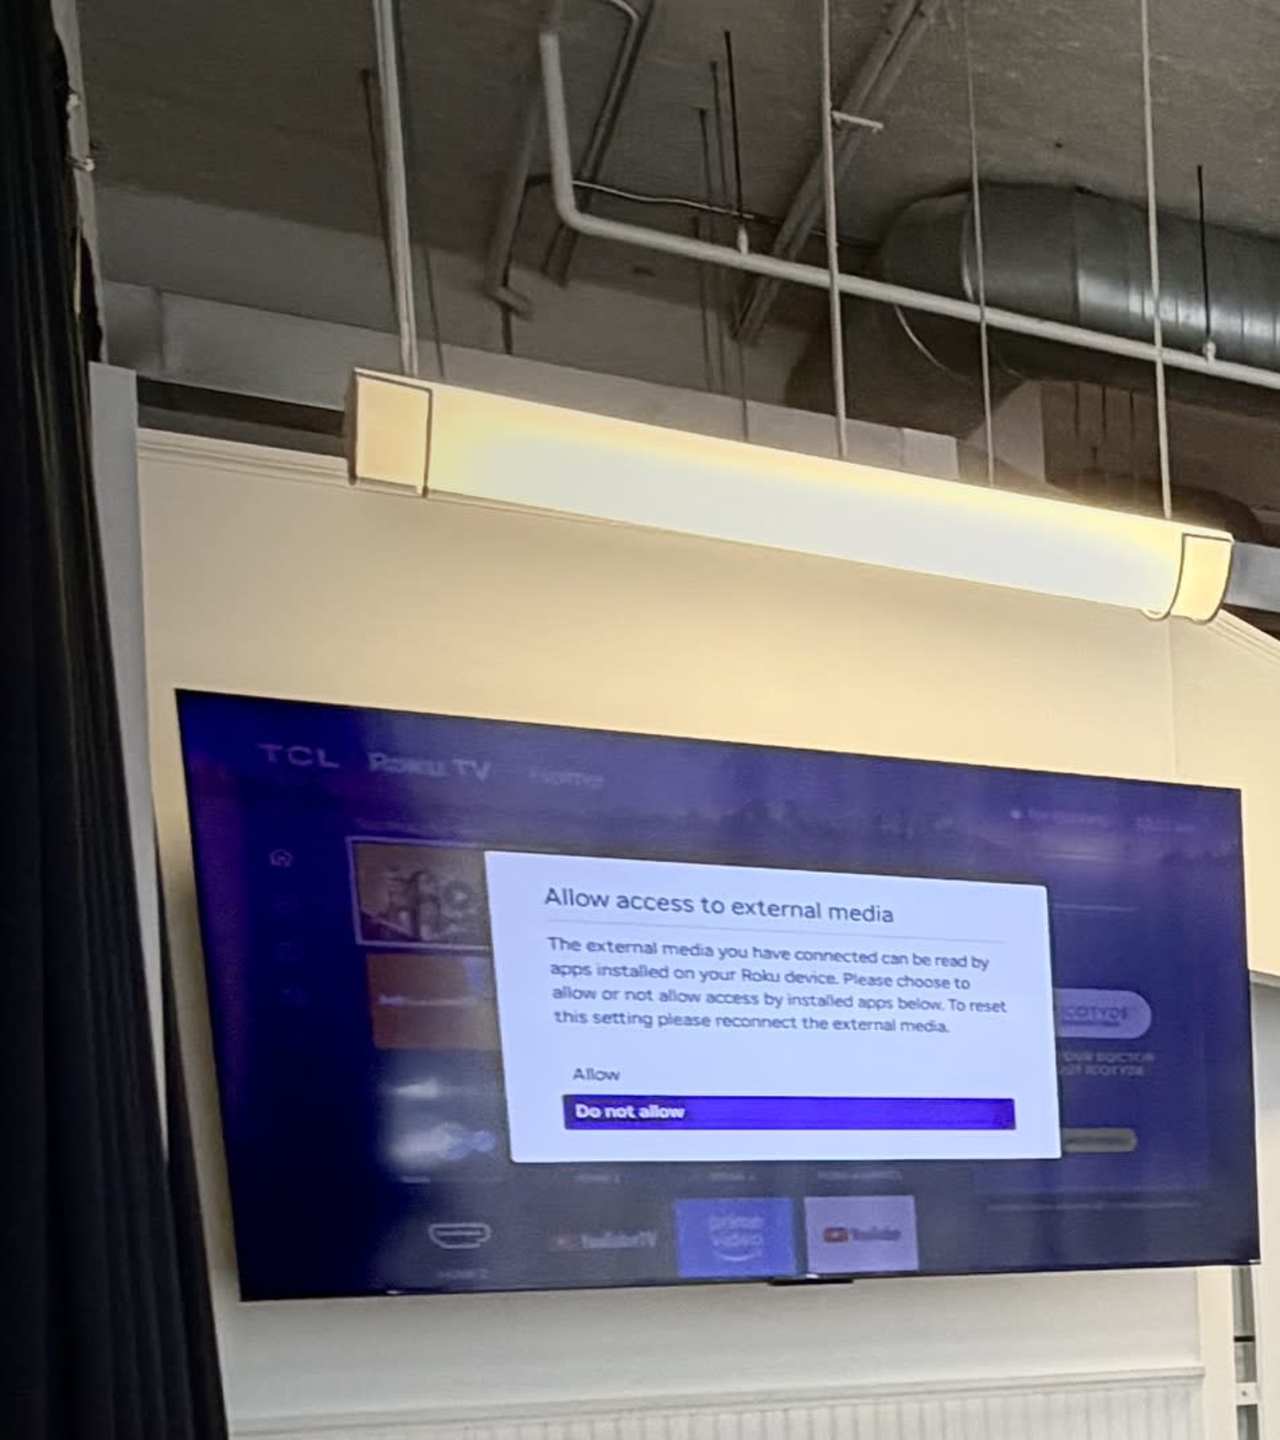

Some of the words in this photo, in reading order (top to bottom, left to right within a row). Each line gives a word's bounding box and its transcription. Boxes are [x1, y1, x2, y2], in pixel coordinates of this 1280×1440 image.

[258, 744, 339, 768] TCL
[453, 758, 492, 781] TV
[545, 887, 610, 908] Allow
[616, 894, 695, 913] access
[701, 896, 726, 915] to
[731, 900, 821, 920] external
[829, 904, 894, 923] media
[548, 936, 582, 952] The
[586, 941, 658, 955] external
[662, 943, 714, 957] media
[718, 946, 749, 961] you
[752, 946, 791, 961] have
[794, 951, 878, 965] connected
[882, 954, 909, 966] can
[912, 954, 931, 967] be
[935, 956, 968, 969] read
[971, 957, 990, 972] by
[550, 963, 592, 977] apps
[596, 964, 669, 980] installed
[673, 968, 695, 980] on
[700, 969, 736, 984] your
[741, 968, 780, 983] Roku
[784, 971, 839, 985] device.
[843, 973, 893, 988] Please
[897, 975, 951, 990] choose
[954, 977, 971, 990] to
[552, 986, 596, 1001] allow
[601, 988, 618, 1001] or
[625, 988, 654, 1001] not
[659, 989, 702, 1004] allow
[706, 993, 759, 1006] access
[763, 992, 783, 1009] by
[787, 994, 854, 1009] installed
[858, 998, 893, 1012] apps
[897, 997, 945, 1012] below.
[948, 999, 966, 1012] To
[969, 1001, 1007, 1014] reset
[554, 1010, 588, 1024] this
[592, 1011, 653, 1028] setting
[657, 1013, 711, 1027] please
[715, 1015, 798, 1030] reconnect
[802, 1015, 829, 1030] the
[832, 1017, 897, 1032] external
[901, 1020, 950, 1034] media.
[573, 1068, 620, 1081] Allow
[574, 1103, 602, 1118] Do
[605, 1106, 635, 1118] not
[638, 1105, 686, 1119] allow
